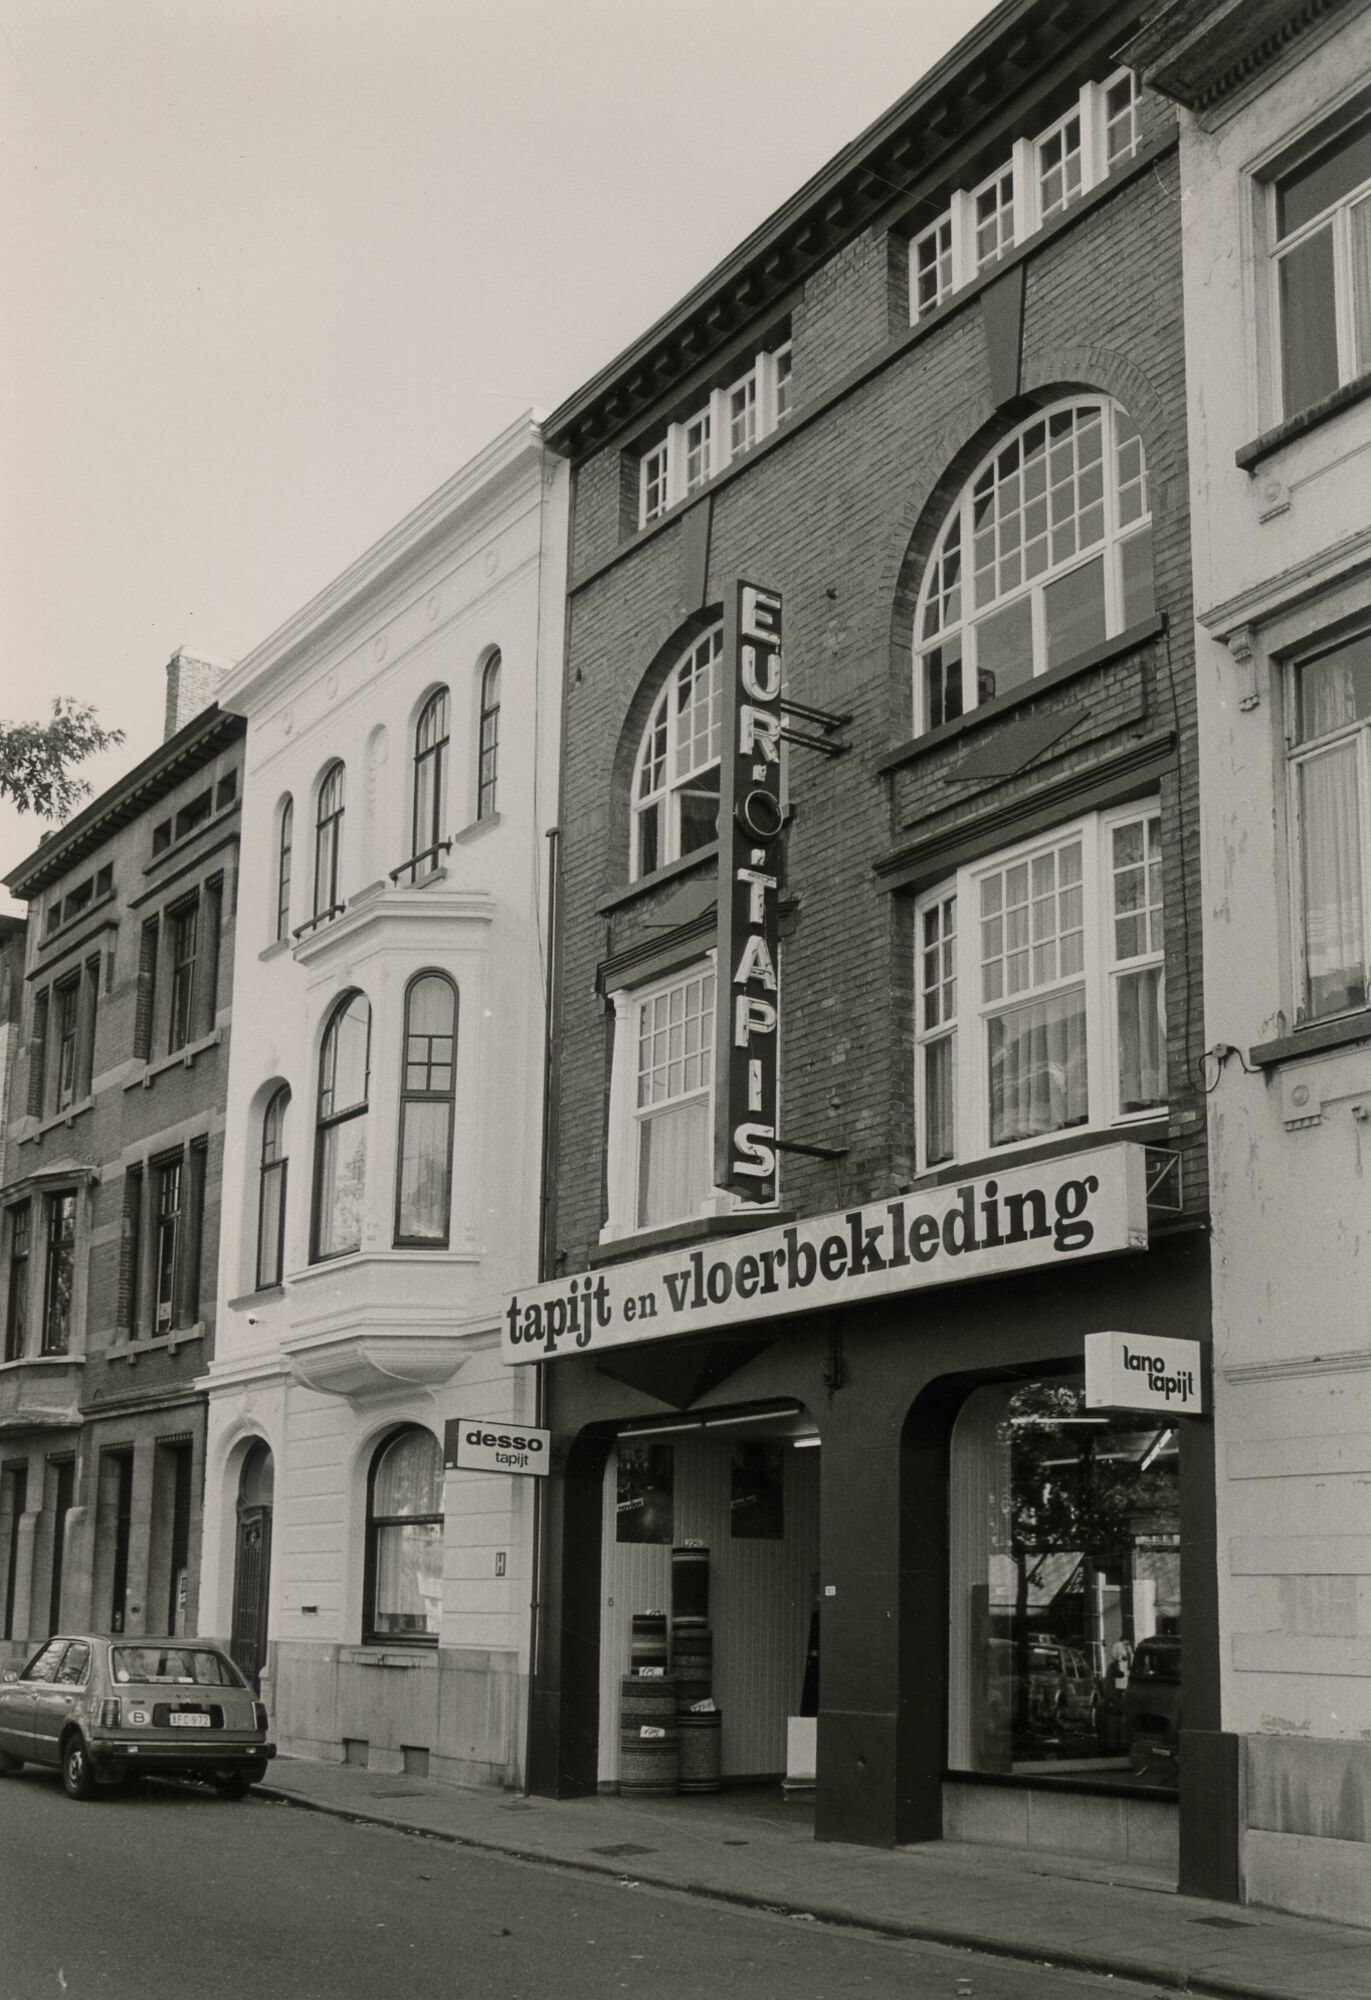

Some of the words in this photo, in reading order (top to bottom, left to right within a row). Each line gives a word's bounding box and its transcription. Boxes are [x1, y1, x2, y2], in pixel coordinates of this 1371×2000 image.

[507, 1275, 612, 1353] tapijt
[624, 1292, 658, 1322] en
[662, 1174, 1100, 1313] vloerbekleding
[1123, 1345, 1165, 1373] lano
[1148, 1371, 1194, 1402] tapijt
[466, 1430, 543, 1452] desso
[496, 1452, 528, 1468] tapijt
[134, 1713, 144, 1723] B
